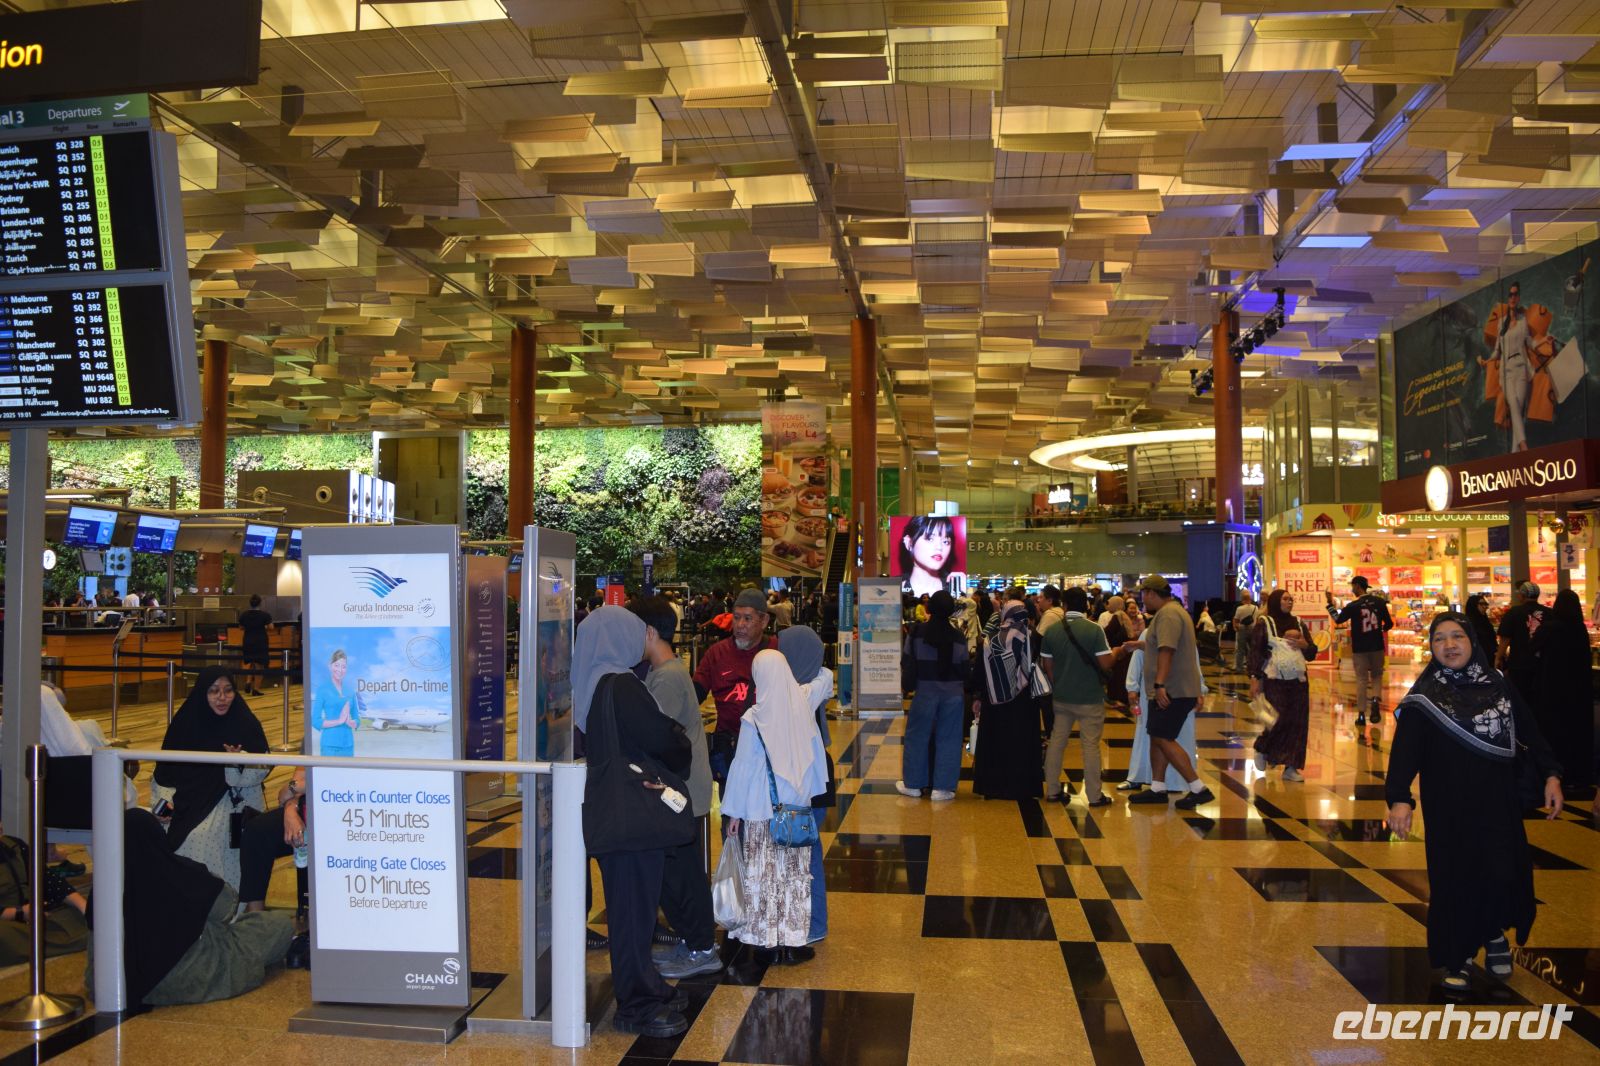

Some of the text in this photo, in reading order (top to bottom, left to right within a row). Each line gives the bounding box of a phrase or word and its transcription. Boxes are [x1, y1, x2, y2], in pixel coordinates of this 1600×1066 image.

[16, 111, 24, 124] 3
[48, 107, 102, 120] Departures
[0, 146, 19, 154] unich
[57, 154, 68, 162] SQ
[58, 166, 69, 174] SQ
[14, 180, 49, 190] York-EWR
[60, 178, 70, 187] SQ
[61, 191, 72, 199] SQ
[0, 196, 24, 204] Sydney
[1, 207, 30, 216] Brisbane
[62, 203, 72, 211] SQ
[2, 218, 44, 227] London-LHR
[64, 216, 74, 224] SQ
[65, 228, 76, 236] SQ
[66, 240, 77, 248] SQ
[68, 252, 78, 260] SQ
[69, 263, 80, 272] SQ
[12, 306, 52, 314] Istanbul-IST
[806, 430, 816, 438] L4
[1284, 580, 1326, 592] FREE
[344, 602, 414, 612] Garuda Indonesia
[1361, 608, 1378, 632] 24
[358, 678, 448, 694] Depart On-time
[321, 790, 451, 804] Check in Counter Closes
[342, 808, 430, 828] 45 Minutes
[347, 829, 425, 844] Before Departure
[327, 855, 446, 872] Boarding Gate Closes
[345, 874, 431, 895] 10 Minutes
[349, 896, 428, 911] Before Departure
[405, 973, 458, 985] CHANGI
